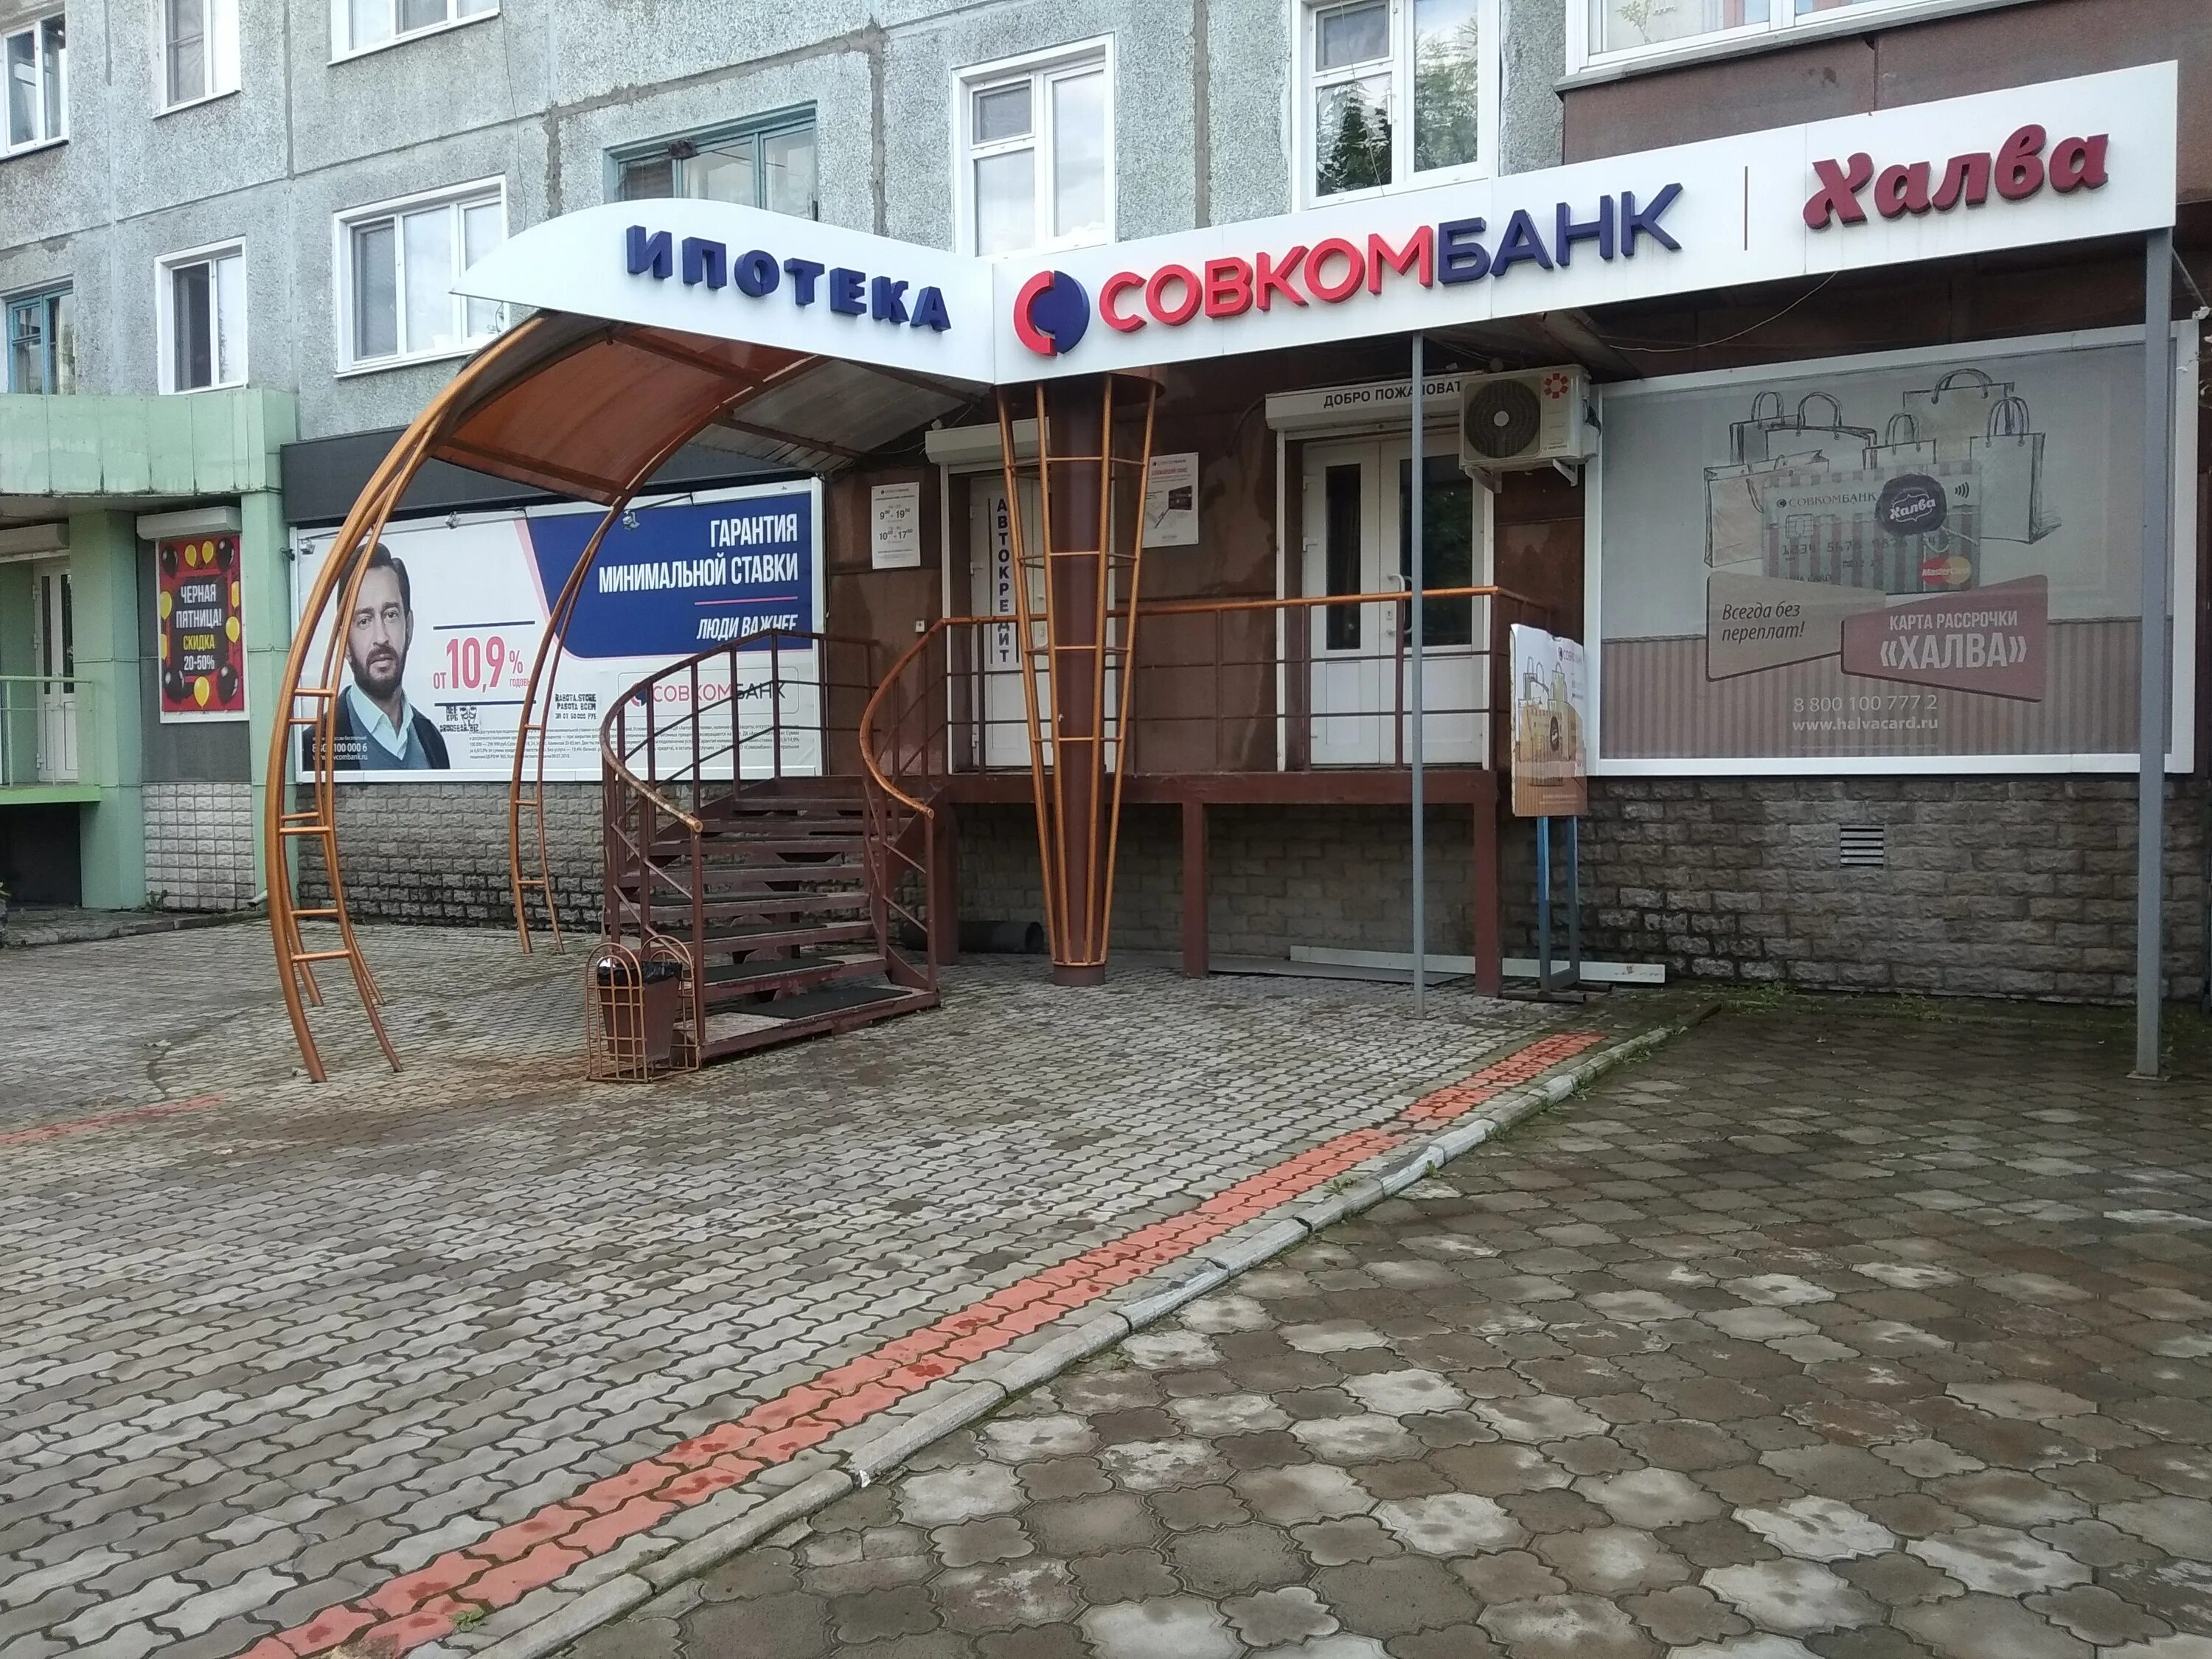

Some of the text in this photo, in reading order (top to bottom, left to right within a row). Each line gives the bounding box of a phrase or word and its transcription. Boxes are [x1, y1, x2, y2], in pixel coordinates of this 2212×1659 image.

[1803, 123, 2109, 230] Халва
[1099, 182, 1683, 333] СОВКОМБАНК
[626, 225, 952, 333] ИПОТЕКА
[1324, 389, 1371, 408] ДОБРО
[1789, 493, 1877, 507] СОВКОМБАНК
[1888, 496, 1936, 521] Халва
[709, 513, 798, 548] ГАРАНТИЯ
[598, 552, 799, 594] МИНИМАЛЬНОЙ СТАВКИ
[180, 584, 216, 604] ЧЕРНАЯ
[175, 608, 222, 629] ПЯТНИЦА!
[1721, 601, 1801, 621] Всегда без
[1889, 611, 2018, 631] КАРТА РАССРОЧКИ
[696, 616, 739, 641] ЛЮДИ
[1721, 621, 1806, 644] переплат!
[183, 634, 215, 651] СКИДКА
[1879, 632, 2028, 670] «ХАЛВА»
[184, 655, 215, 671] 20-50%
[446, 636, 505, 693] 10,9
[557, 702, 578, 710] РАБОТА
[1794, 695, 1938, 712] 8 800 100 777 2
[1792, 715, 1938, 731] www.halvacard.ru
[347, 742, 361, 752] 000
[362, 742, 367, 752] 6
